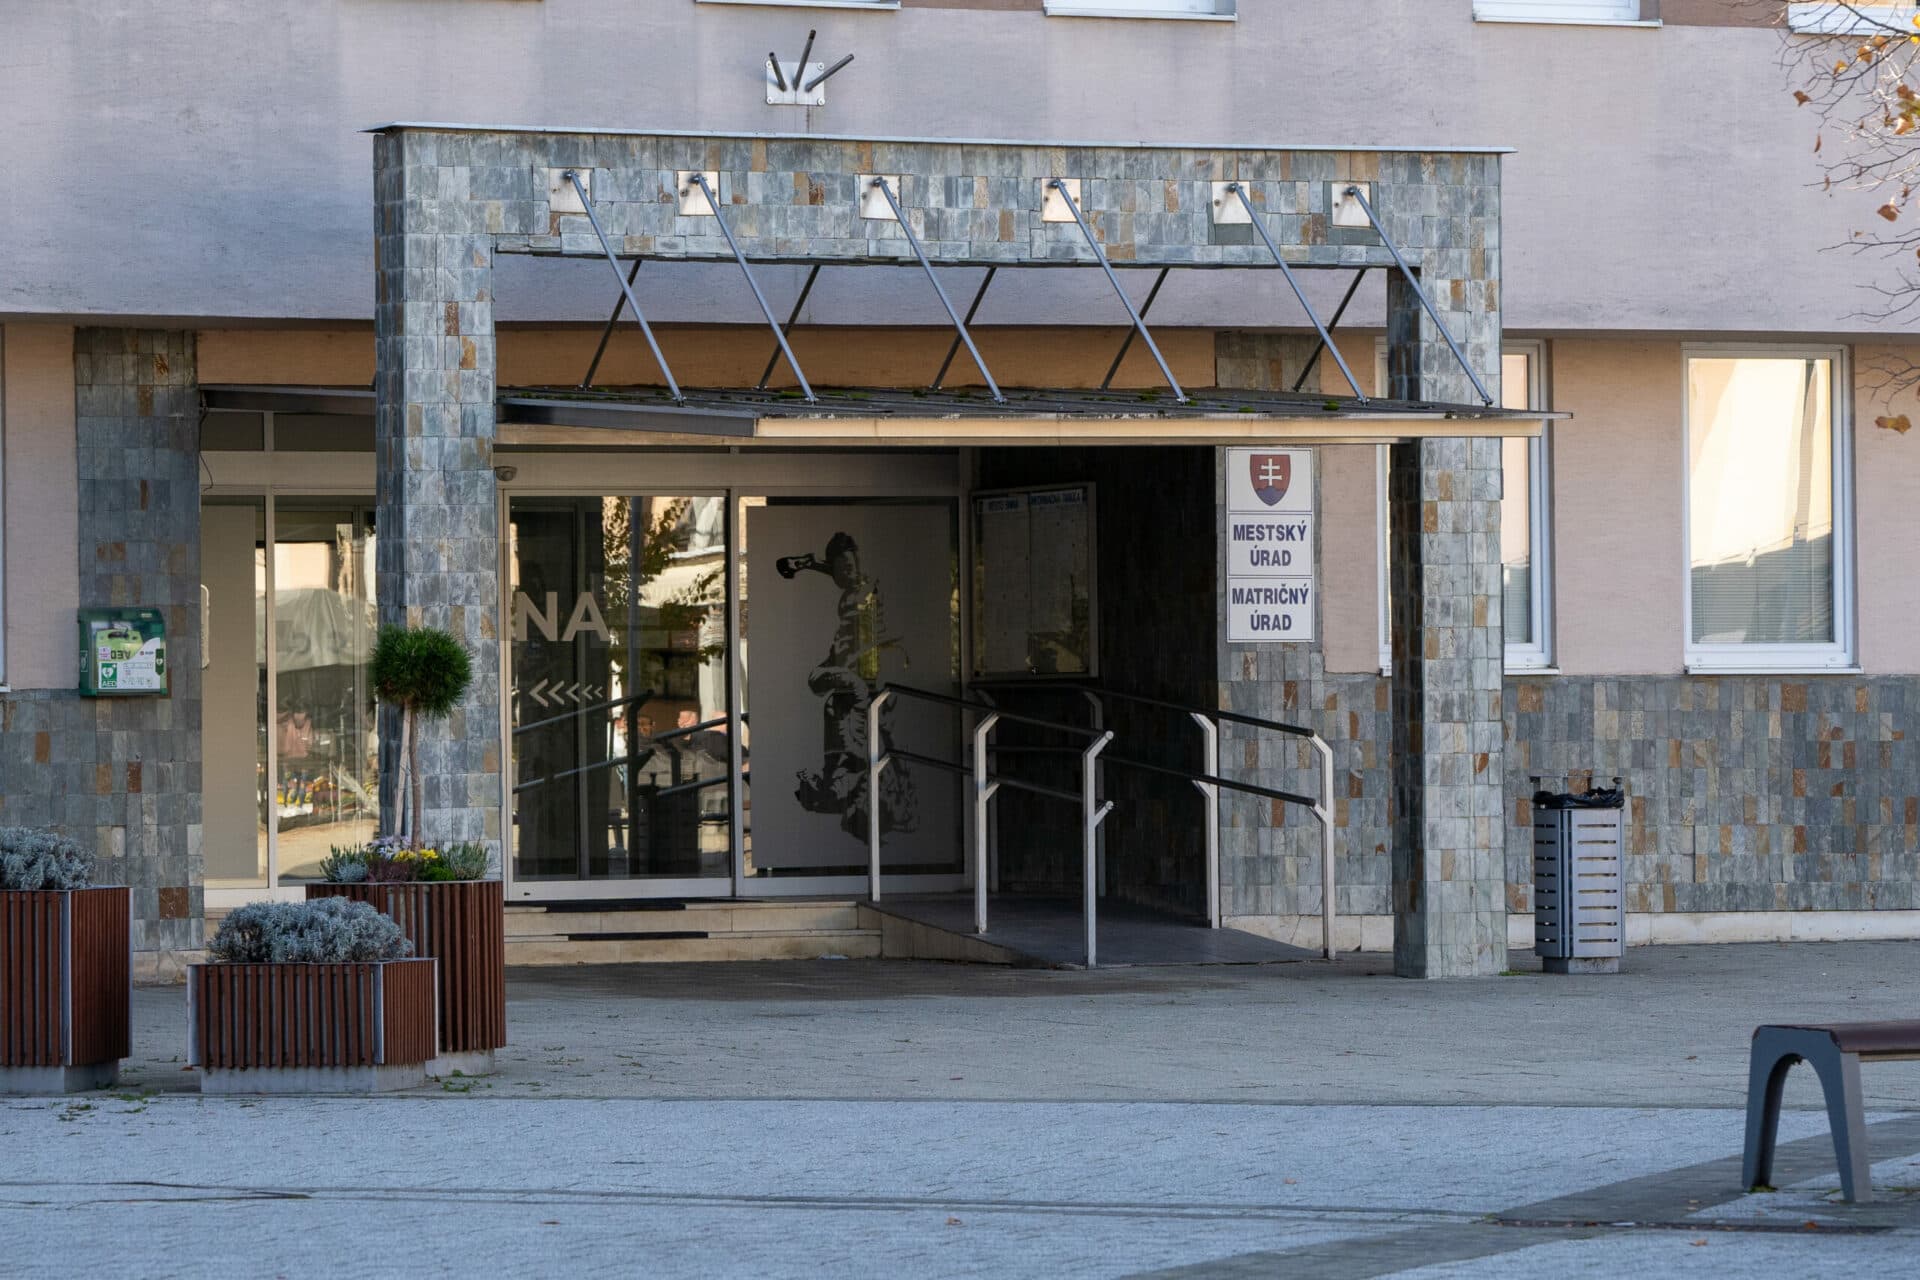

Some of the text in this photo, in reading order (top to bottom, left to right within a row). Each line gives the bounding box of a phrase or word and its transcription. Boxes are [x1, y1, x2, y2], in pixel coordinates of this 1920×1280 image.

[1233, 520, 1307, 541] MESTSKÝ
[1250, 544, 1292, 567] ÚRAD
[1232, 583, 1309, 605] MATRIČNÝ
[515, 591, 611, 642] NA
[1250, 609, 1293, 632] ÚRAD
